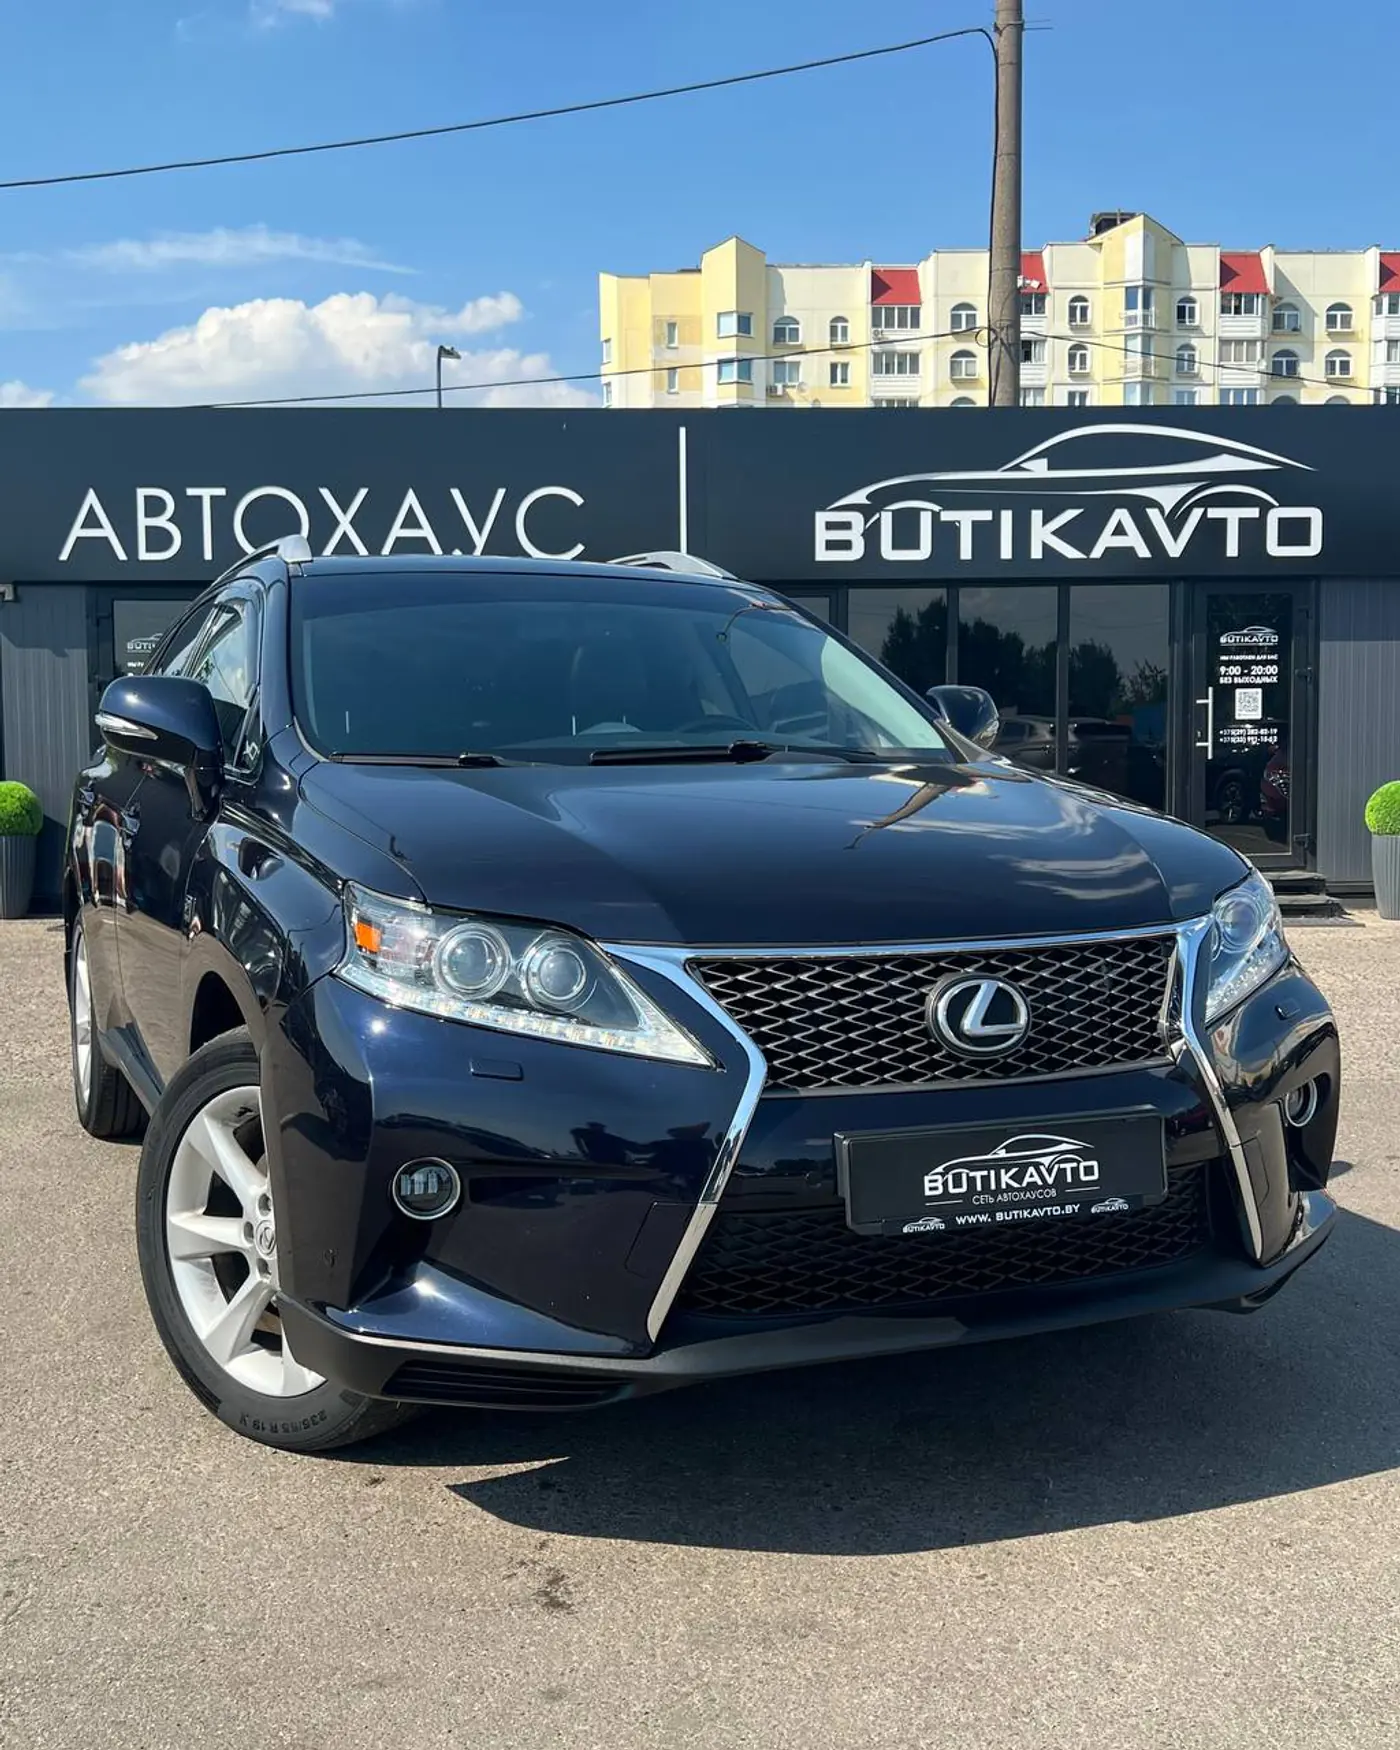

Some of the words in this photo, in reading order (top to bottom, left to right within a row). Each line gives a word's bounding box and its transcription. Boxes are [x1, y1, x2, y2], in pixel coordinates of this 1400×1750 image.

[58, 485, 586, 561] АВТОХАУС
[814, 505, 1324, 562] BUTIKAVTO
[1219, 665, 1242, 675] 9:00
[1250, 664, 1279, 675] 20:00
[1219, 676, 1232, 684] БЕЗ
[1233, 675, 1278, 684] ВЫХОДНЫХ
[923, 1160, 1100, 1196] BUTIKAVTO
[971, 1194, 995, 1206] СЕТЬ
[996, 1187, 1058, 1203] АВТОХАУСОВ
[955, 1213, 992, 1225] WWW.
[995, 1203, 1081, 1221] BUTIKAVTO.BY
